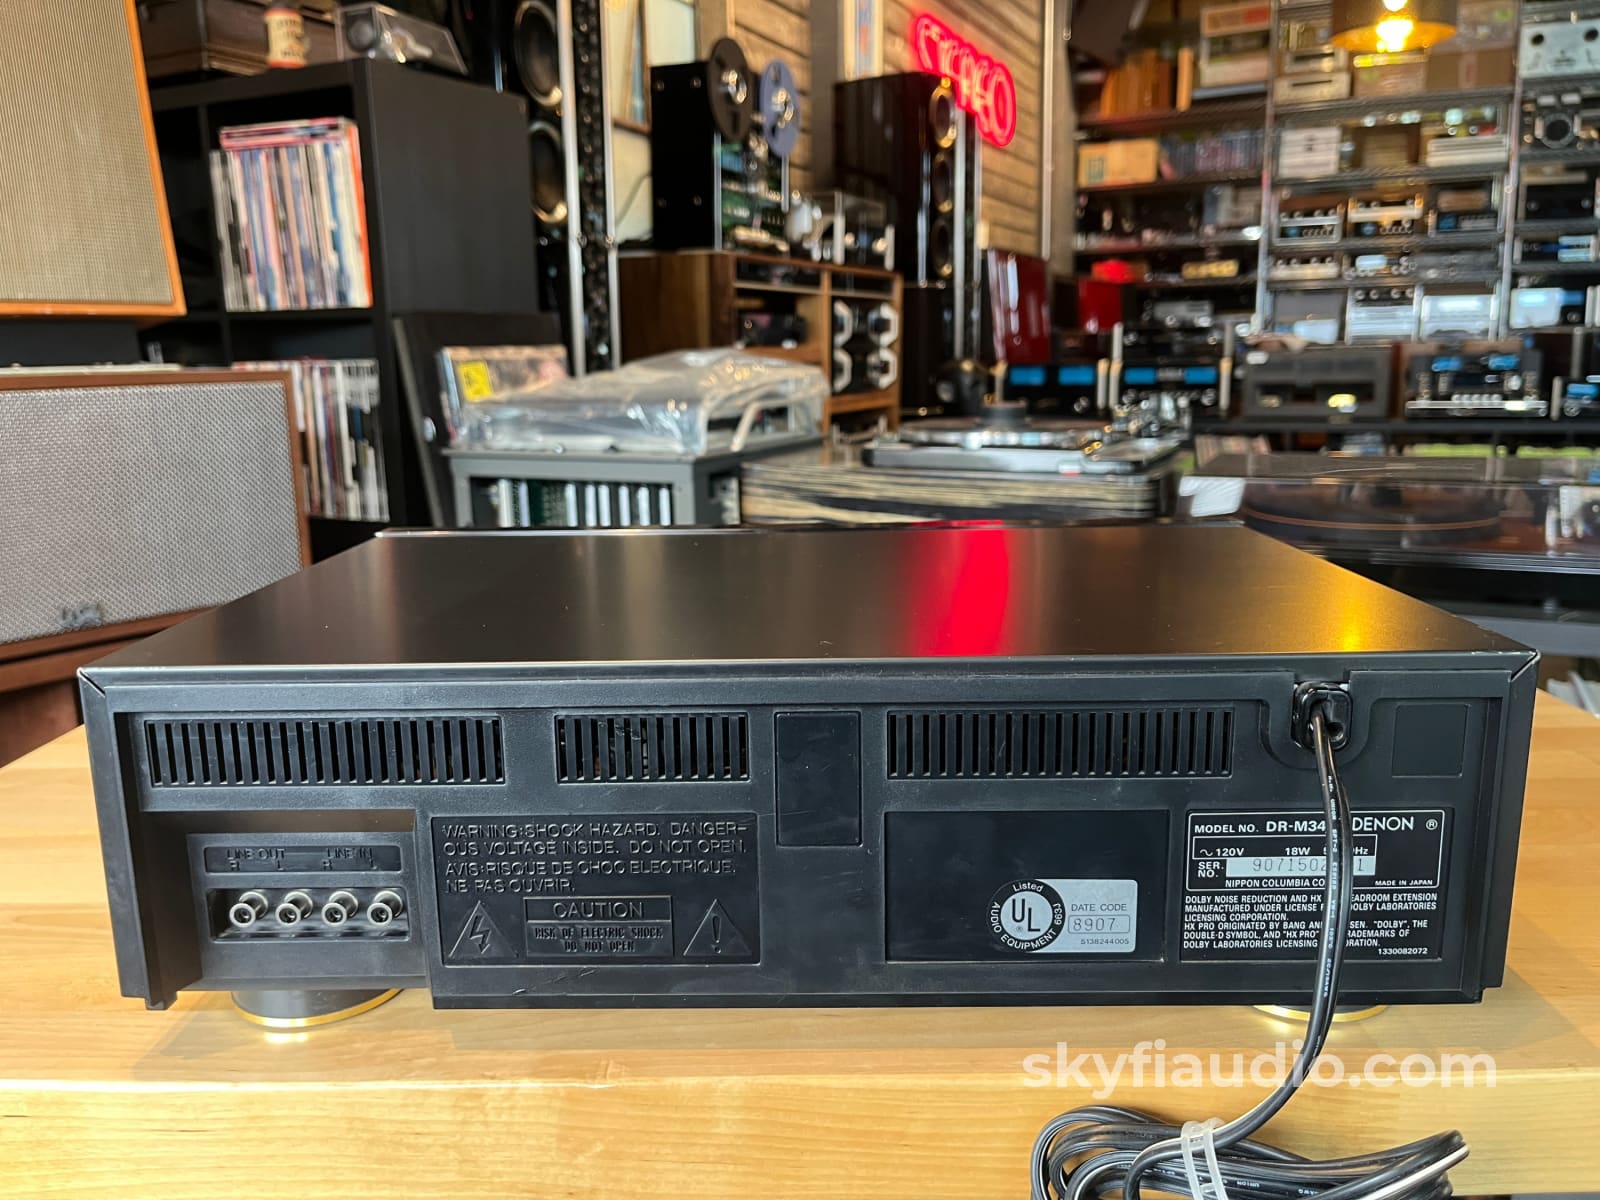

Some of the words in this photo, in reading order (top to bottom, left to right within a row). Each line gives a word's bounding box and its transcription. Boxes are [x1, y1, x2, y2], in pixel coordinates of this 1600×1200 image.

[1194, 825, 1235, 834] MODEL
[1238, 824, 1259, 833] NO.
[1352, 816, 1414, 831] DENON
[589, 822, 660, 837] HAZARD.
[443, 841, 479, 855] OUS
[483, 840, 557, 855] VOLTAGE
[562, 840, 619, 855] INSIDE.
[629, 840, 654, 854] DO
[659, 839, 692, 853] NOT
[697, 839, 747, 853] OPEN.
[1216, 847, 1245, 856] 120V
[1285, 847, 1311, 856] 18W
[227, 848, 253, 860] LINE
[258, 848, 285, 859] OUT
[327, 848, 354, 859] LINE
[359, 848, 373, 859] IN
[551, 860, 574, 875] DE
[577, 860, 625, 875] CHOC
[629, 859, 736, 874] ELECTRIQUE.
[1197, 861, 1224, 870] SER.
[1197, 870, 1219, 878] NO.
[445, 879, 468, 893] NE
[474, 878, 506, 893] PAS
[508, 878, 575, 893] OUVRIR.
[1012, 882, 1044, 893] Listed
[1225, 880, 1260, 888] NIPPON
[1261, 879, 1310, 888] COLUMBIA
[1185, 895, 1212, 904] DOLBY
[1214, 895, 1239, 903] NOISE
[1241, 895, 1287, 903] REDUCTION
[1290, 895, 1308, 903] AND
[1310, 894, 1322, 903] HX
[1352, 894, 1390, 902] EADROOM
[1393, 893, 1437, 901] EXTENSION
[553, 902, 642, 918] CAUTION
[1071, 903, 1096, 912] DATE
[1100, 903, 1127, 912] CODE
[1185, 904, 1250, 912] MANUFACTURED
[1254, 904, 1281, 912] UNDER
[1351, 903, 1374, 911] OLBY
[1376, 902, 1437, 910] LABORATORIES
[1012, 898, 1040, 932] UL
[1184, 913, 1227, 922] LICENSING
[1229, 913, 1289, 921] CORPORATION.
[990, 901, 1003, 933] AUDIO
[1000, 928, 1057, 950] EQUIPMENT
[1073, 918, 1116, 932] 8907
[1184, 922, 1196, 930] HX
[1198, 922, 1215, 930] PRO
[1217, 922, 1266, 930] ORIGINATED
[1269, 922, 1280, 930] BY
[1282, 921, 1306, 929] BANG
[1308, 921, 1322, 929] AN
[1350, 920, 1368, 929] SEN.
[1412, 919, 1428, 928] THE
[535, 927, 557, 939] RISK
[561, 927, 574, 939] OF
[580, 927, 625, 939] ELECTRIC
[631, 927, 664, 939] SHOCK
[1225, 931, 1260, 939] SYMBOL,
[1263, 930, 1280, 938] AND
[1283, 930, 1297, 938] "HX
[1299, 930, 1319, 938] PRO"
[1347, 929, 1396, 938] RADEMARKS
[1398, 929, 1410, 937] OF
[564, 940, 578, 952] DO
[584, 940, 604, 952] NOT
[609, 940, 635, 952] OPEN
[1183, 940, 1210, 949] DOLBY
[1213, 940, 1273, 948] LABORATORIES
[1276, 939, 1318, 948] LICENSING
[1346, 939, 1380, 947] RATION.
[1378, 947, 1428, 955] 1330082072
